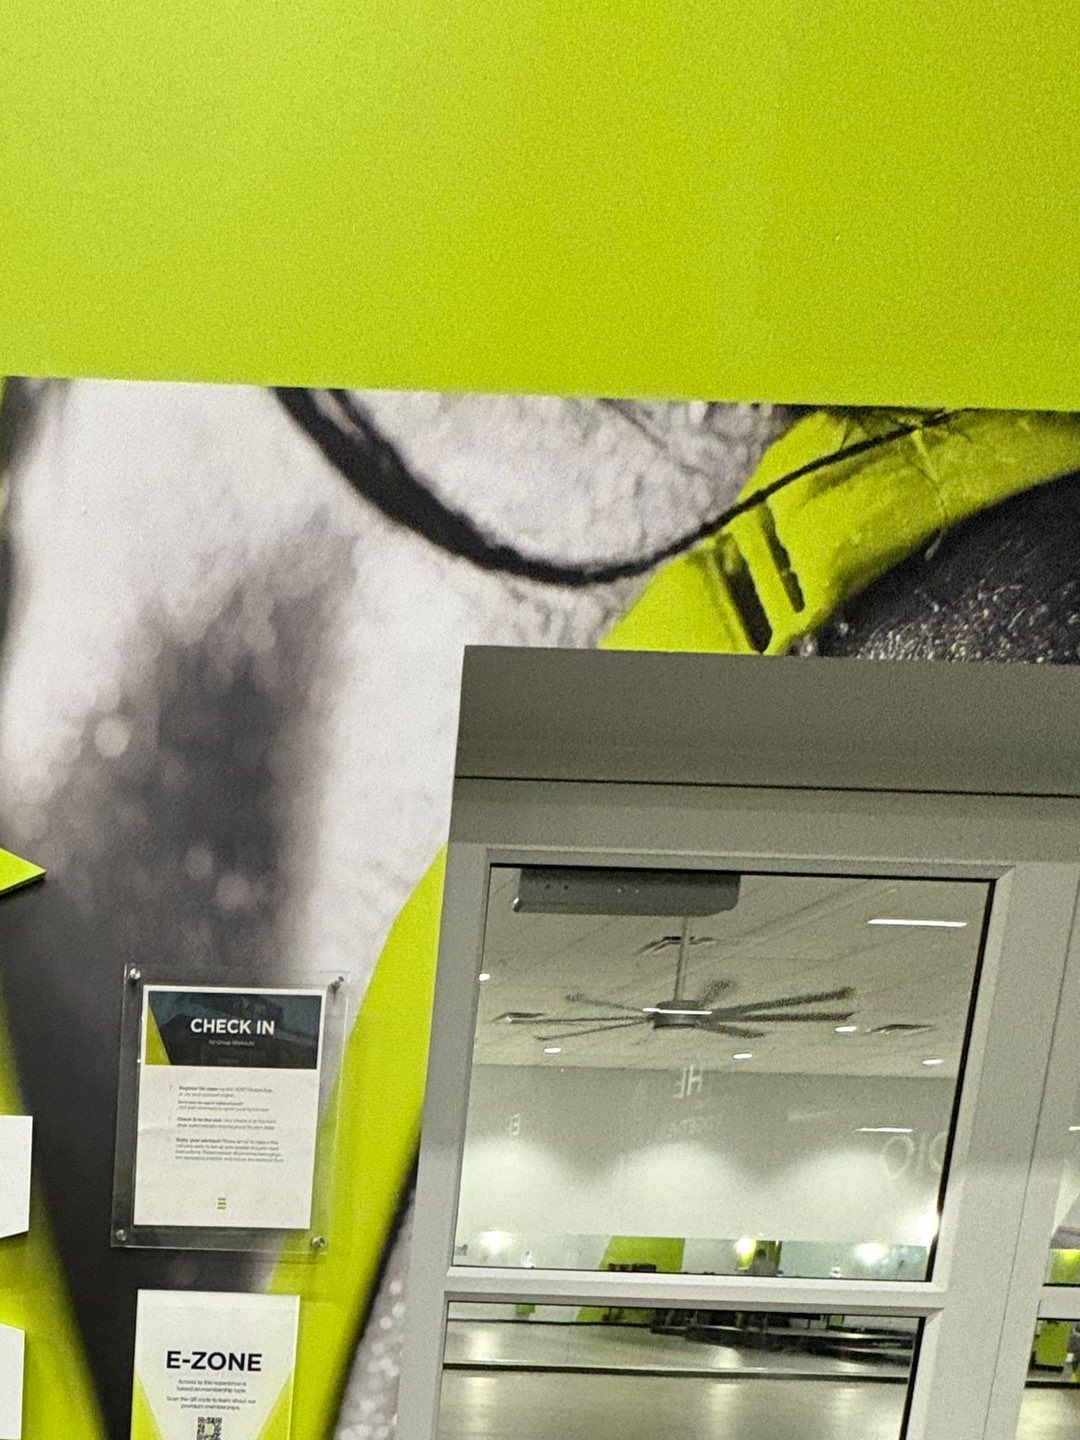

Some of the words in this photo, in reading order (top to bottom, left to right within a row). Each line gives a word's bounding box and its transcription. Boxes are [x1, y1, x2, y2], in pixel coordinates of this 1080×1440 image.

[190, 1018, 252, 1035] CHECK
[256, 1020, 275, 1036] IN
[166, 1350, 262, 1372] E-ZONE
